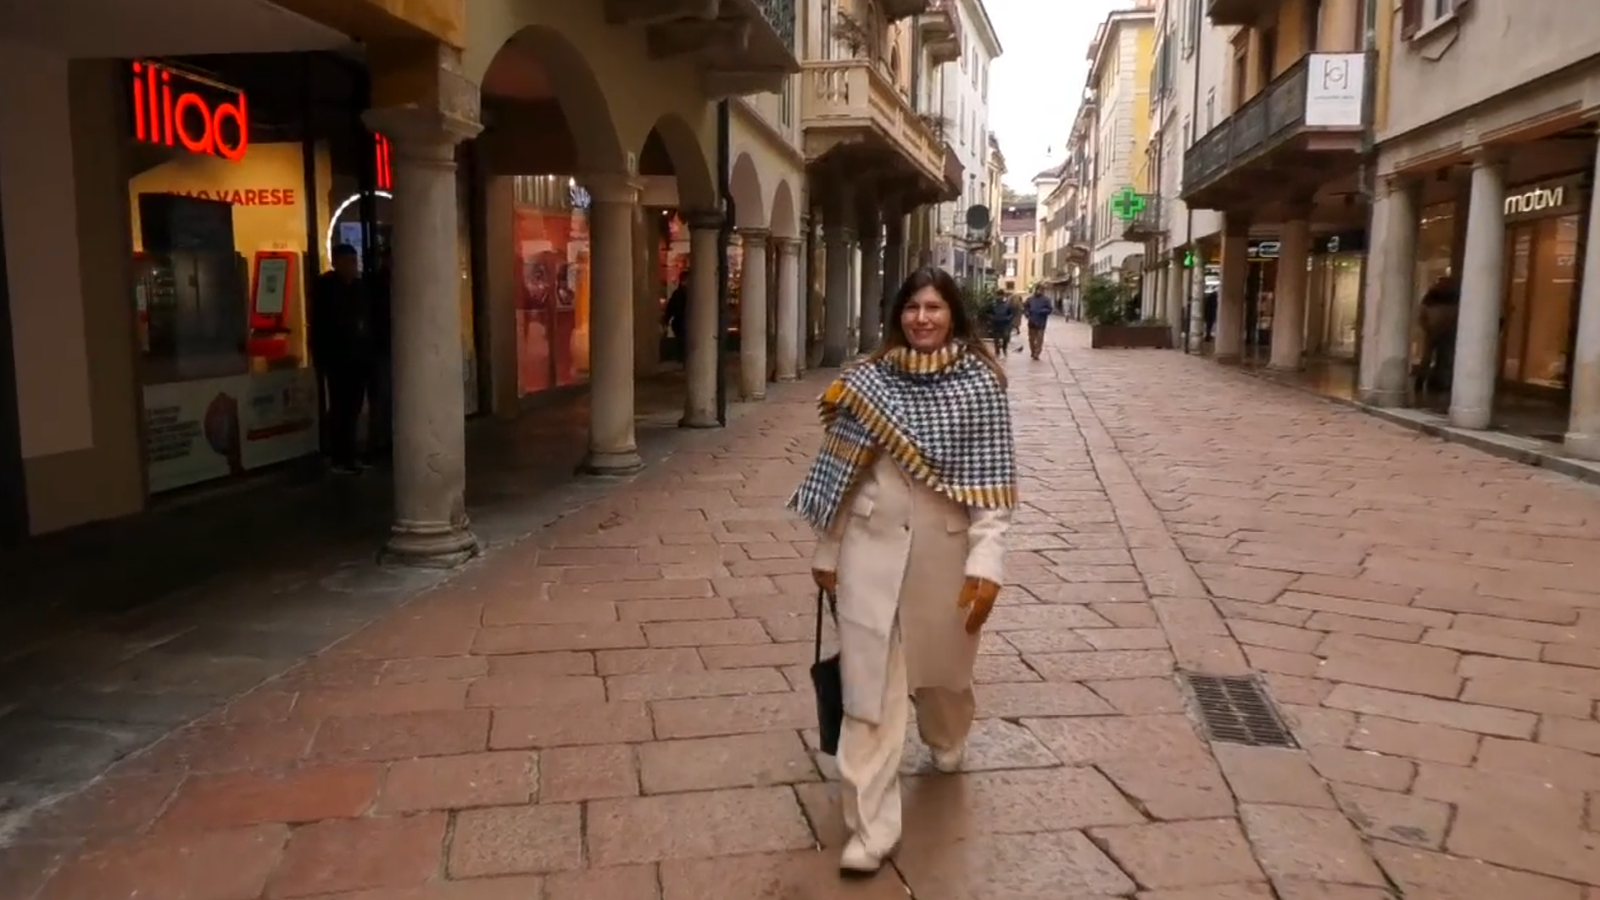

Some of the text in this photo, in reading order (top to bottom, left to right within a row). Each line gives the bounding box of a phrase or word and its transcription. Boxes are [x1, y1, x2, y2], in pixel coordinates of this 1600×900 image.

[133, 61, 248, 163] iliad
[215, 189, 295, 206] VARESE
[1504, 186, 1563, 215] motivi
